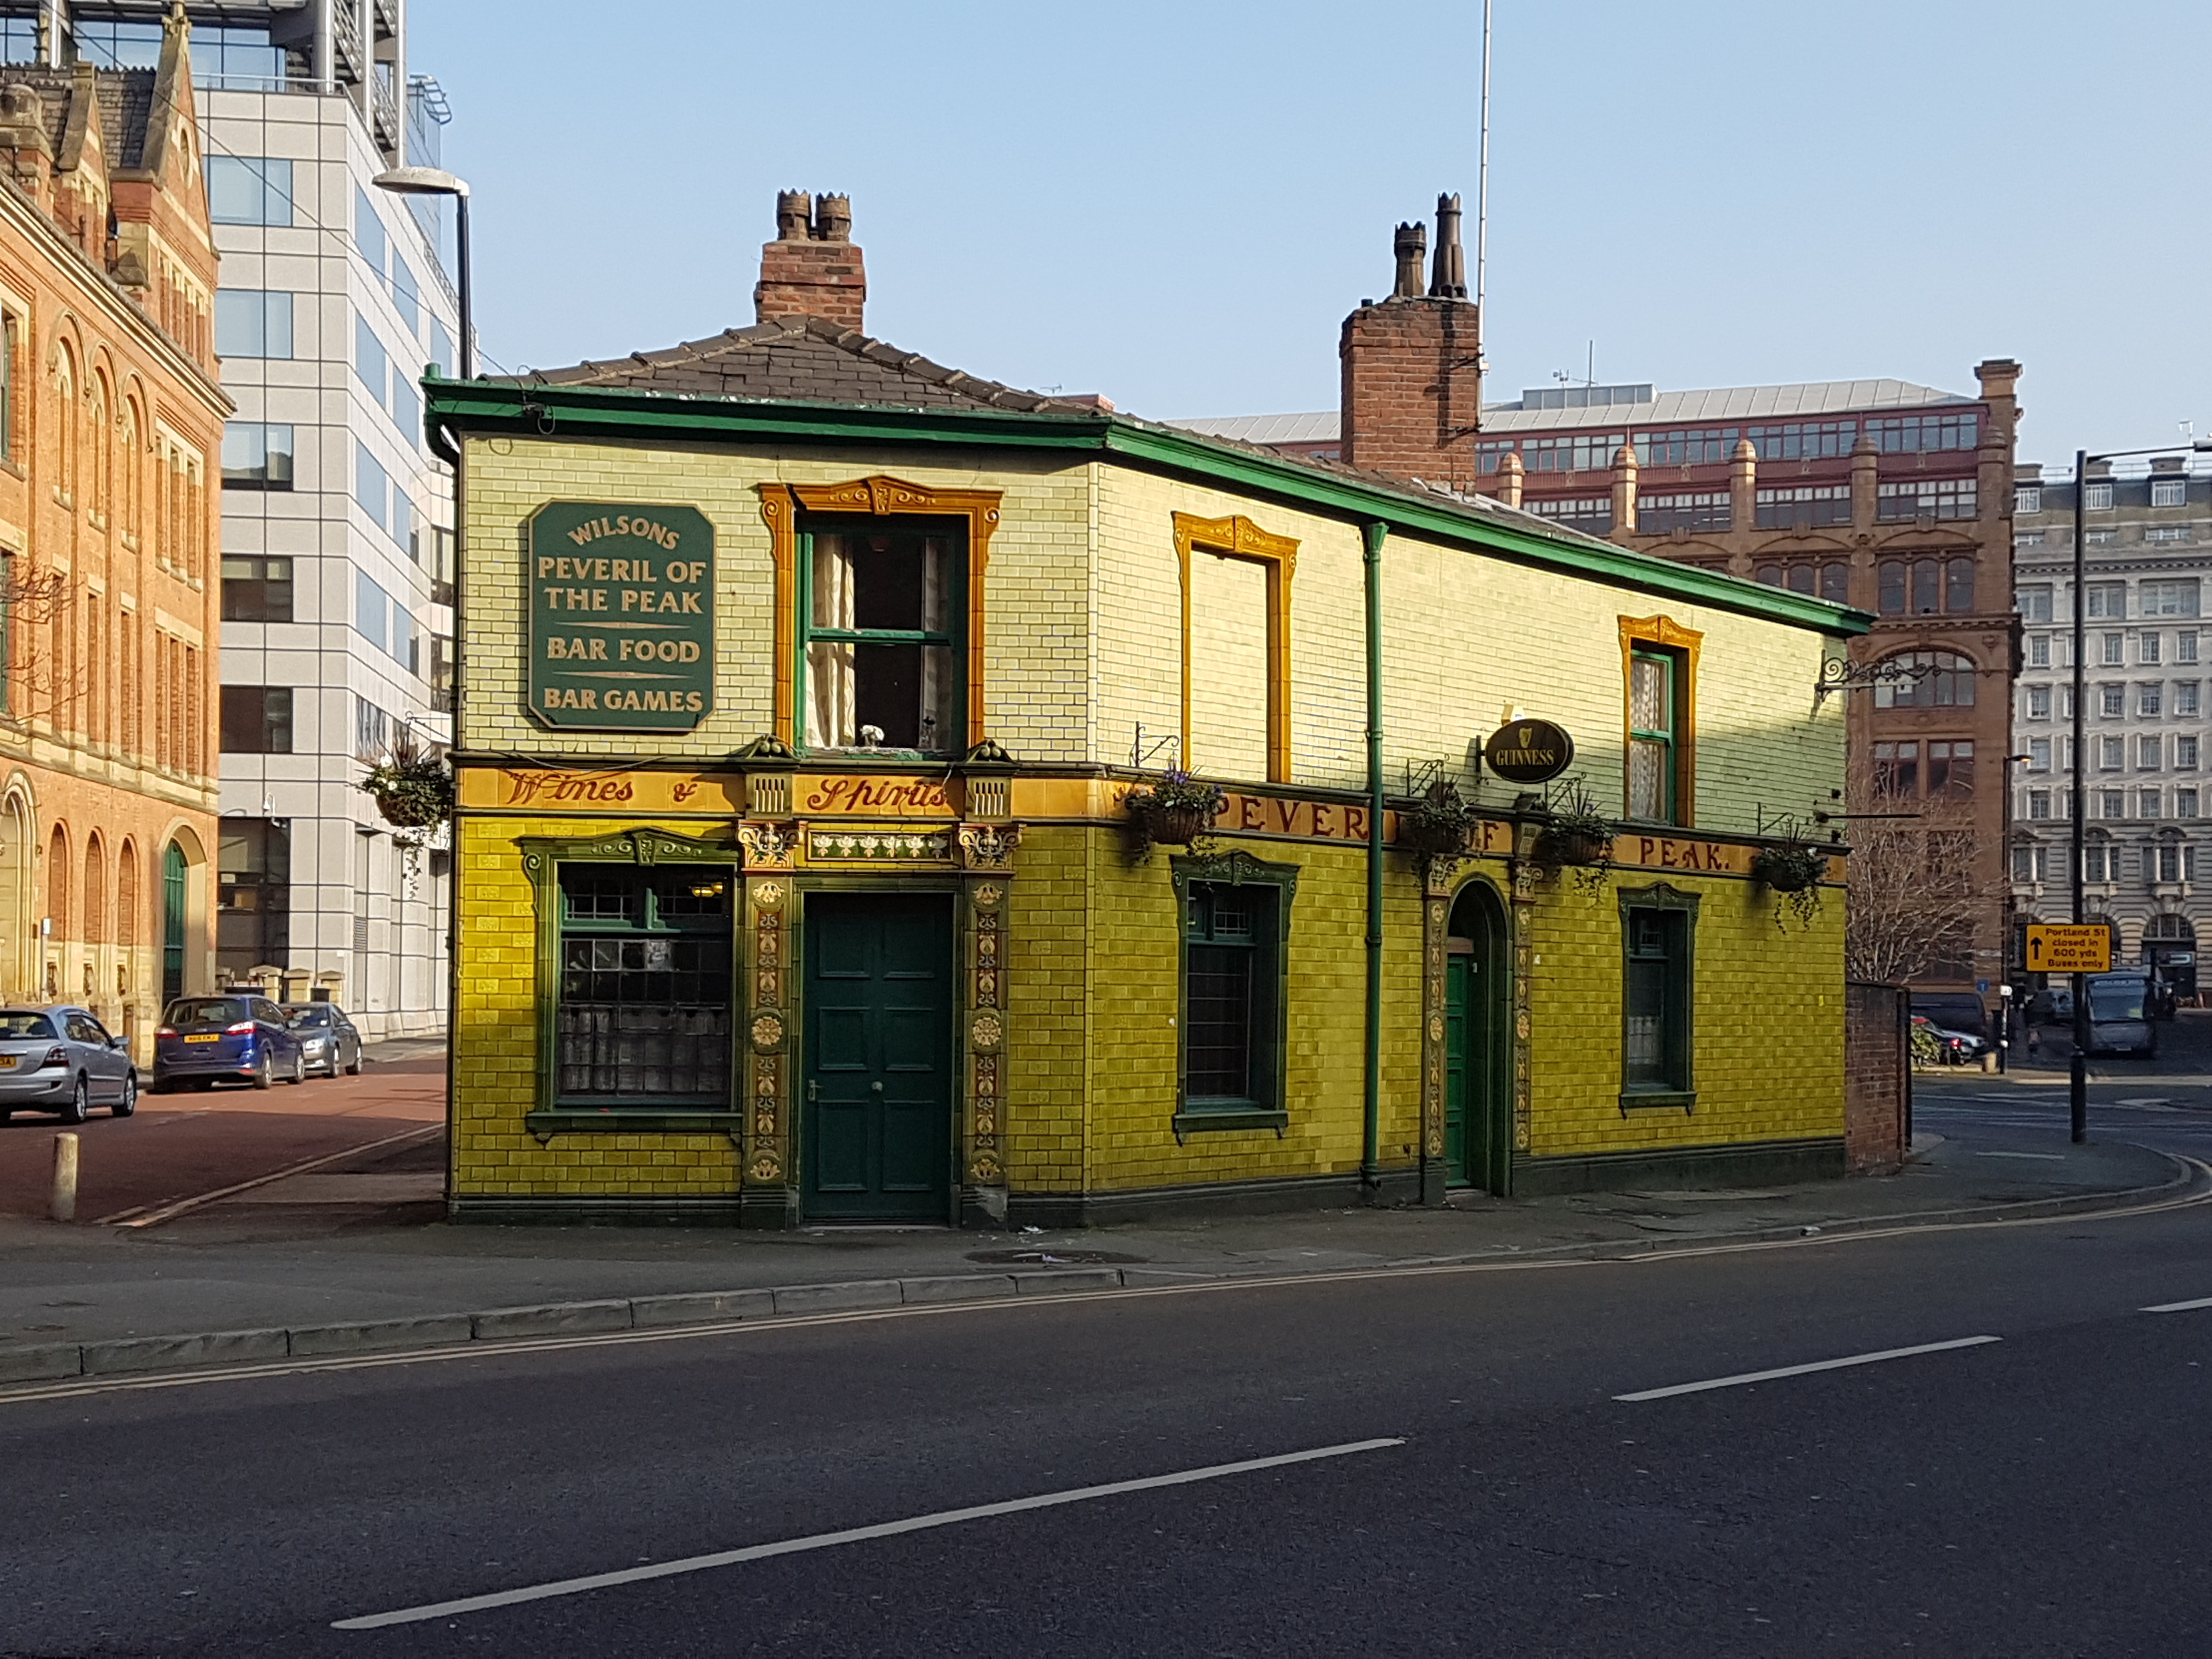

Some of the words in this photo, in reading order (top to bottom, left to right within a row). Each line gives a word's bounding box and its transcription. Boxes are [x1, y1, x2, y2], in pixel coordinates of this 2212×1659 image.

[567, 515, 680, 550] WILSONS
[538, 556, 657, 583] PEVERIL
[666, 561, 707, 584] OF
[543, 587, 608, 611] THE
[620, 589, 704, 614] PEAK
[547, 637, 608, 660] BAR
[619, 639, 700, 663] FOOD
[544, 687, 597, 710] BAR
[604, 690, 703, 712] GAMES
[1496, 749, 1555, 766] GUINNESS
[507, 772, 634, 804] Wines
[674, 782, 697, 802] &
[806, 778, 948, 810] Spirits
[1209, 794, 1401, 844] PEVER
[2045, 928, 2090, 936] Portland
[2094, 928, 2106, 936] St
[2053, 949, 2076, 957] 600
[2080, 950, 2097, 958] yds
[2081, 960, 2104, 968] only
